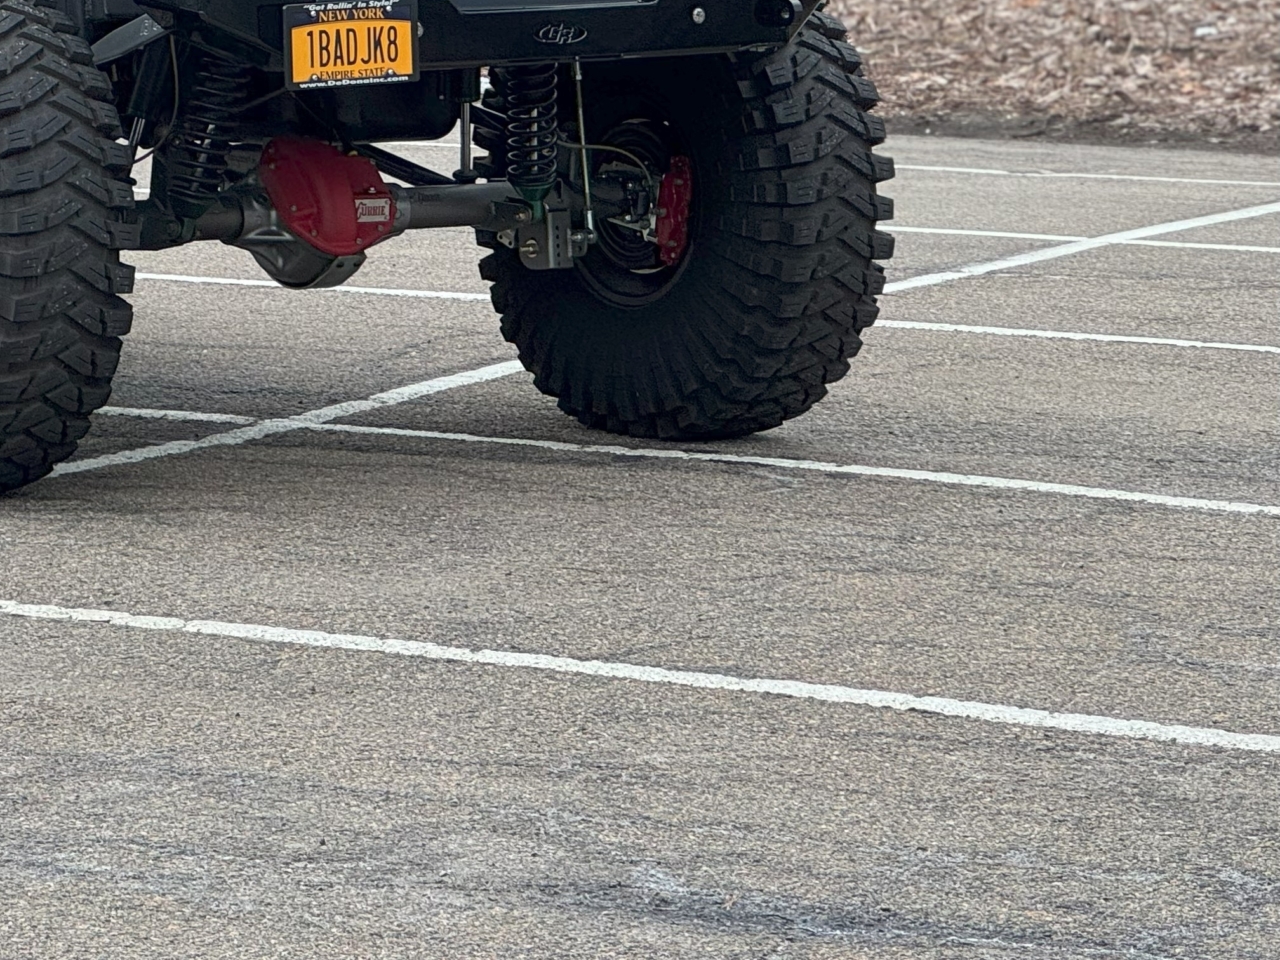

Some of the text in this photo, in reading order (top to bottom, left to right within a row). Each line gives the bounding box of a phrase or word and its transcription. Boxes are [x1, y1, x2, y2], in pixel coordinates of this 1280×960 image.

[318, 8, 384, 22] NEW YORK
[320, 67, 385, 80] EMPIRE STATE
